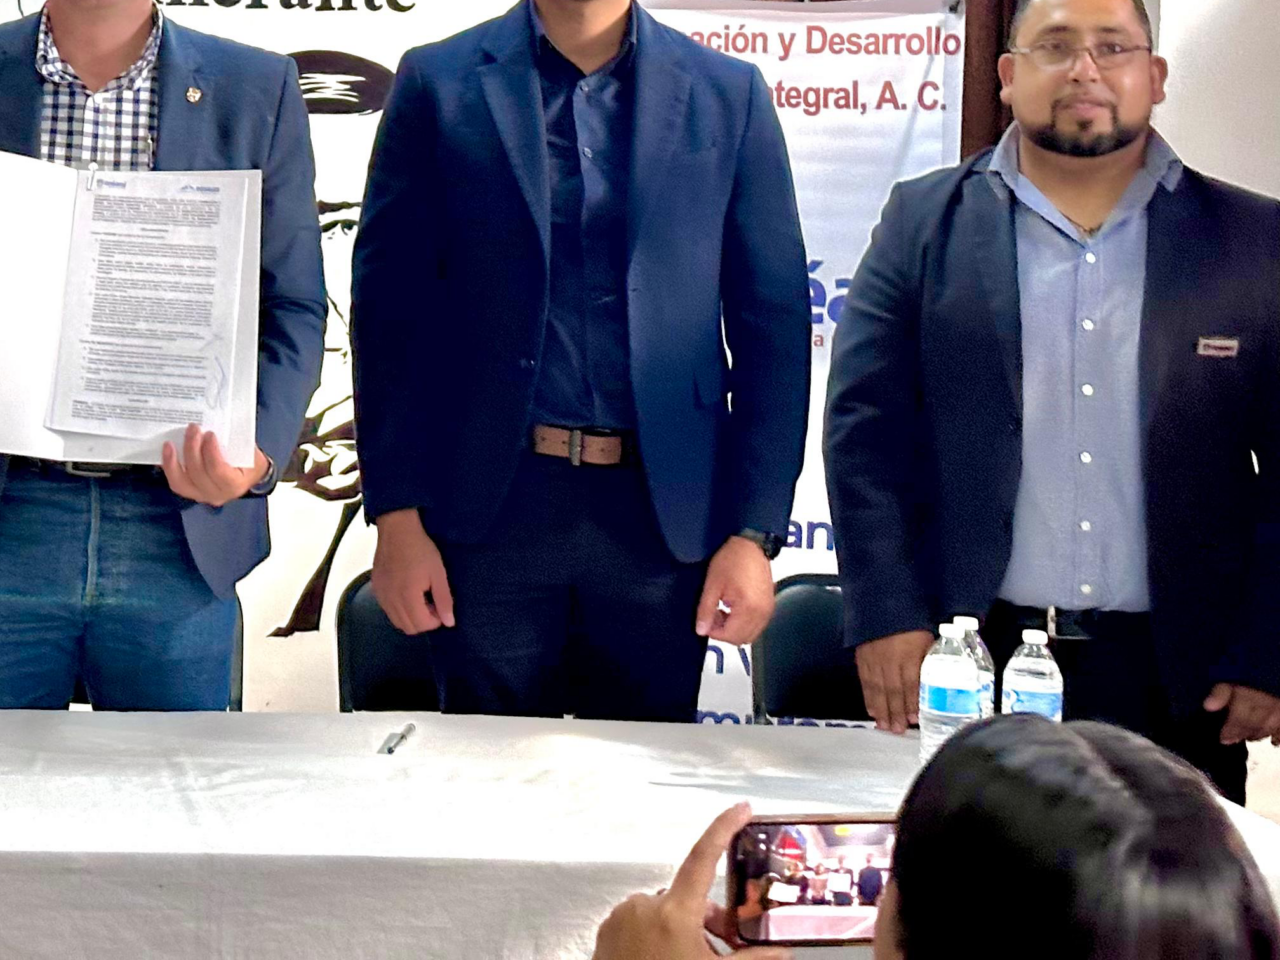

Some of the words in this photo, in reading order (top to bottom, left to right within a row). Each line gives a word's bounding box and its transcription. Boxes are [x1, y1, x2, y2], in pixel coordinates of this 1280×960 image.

[687, 24, 768, 55] ación
[778, 32, 797, 61] y
[805, 25, 962, 56] Desarrollo
[767, 79, 868, 117] tegral,
[875, 80, 908, 111] A.
[916, 80, 947, 111] C.
